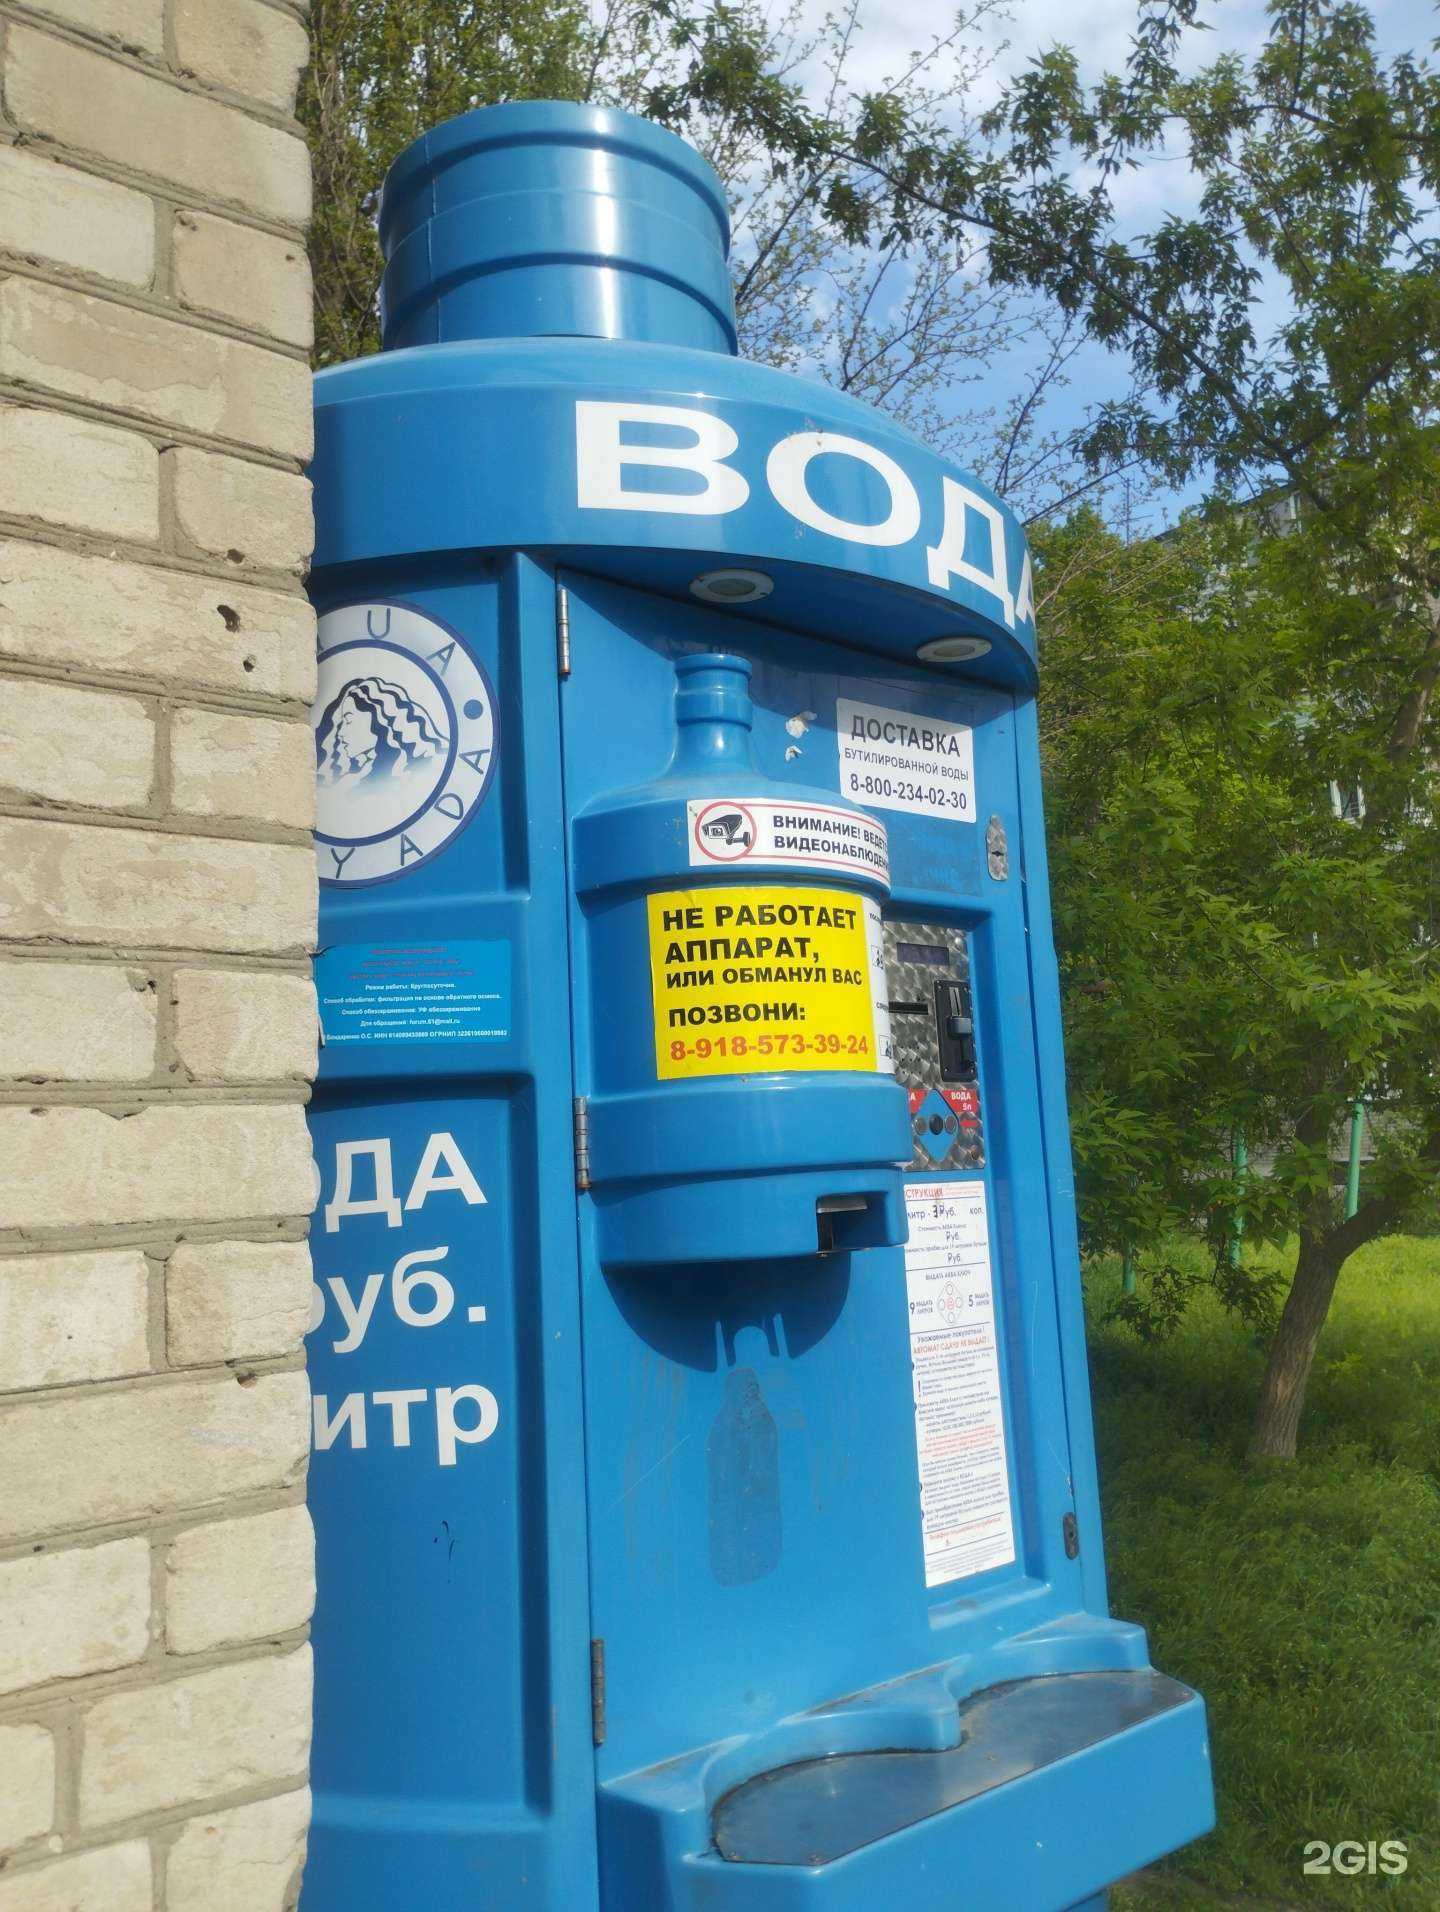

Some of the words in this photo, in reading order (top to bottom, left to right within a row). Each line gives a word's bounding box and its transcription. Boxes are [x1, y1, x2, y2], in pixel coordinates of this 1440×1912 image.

[575, 400, 1035, 630] ВОДА
[851, 715, 961, 757] ДОСТАВКА
[844, 748, 938, 775] БУТИЛИРОВАННОЙ
[941, 766, 969, 782] ВОДЫ
[850, 773, 967, 810] 8-800-234-02-30
[773, 815, 861, 839] ВНИМАНИЕ!
[663, 908, 704, 931] НЕ
[715, 905, 856, 930] РАБОТАЕТ
[664, 937, 819, 964] АППАРАТ,
[666, 970, 714, 989] ИЛИ
[722, 967, 826, 984] ОБМАНУЛ
[832, 968, 862, 986] ВАС
[669, 1003, 805, 1027] ПОЗВОНИ:
[670, 1034, 868, 1061] 8-918-573-39-24
[951, 1091, 972, 1101] ВОДА
[310, 1132, 488, 1233] ДА
[909, 1302, 915, 1315] 9
[968, 1294, 974, 1307] 5
